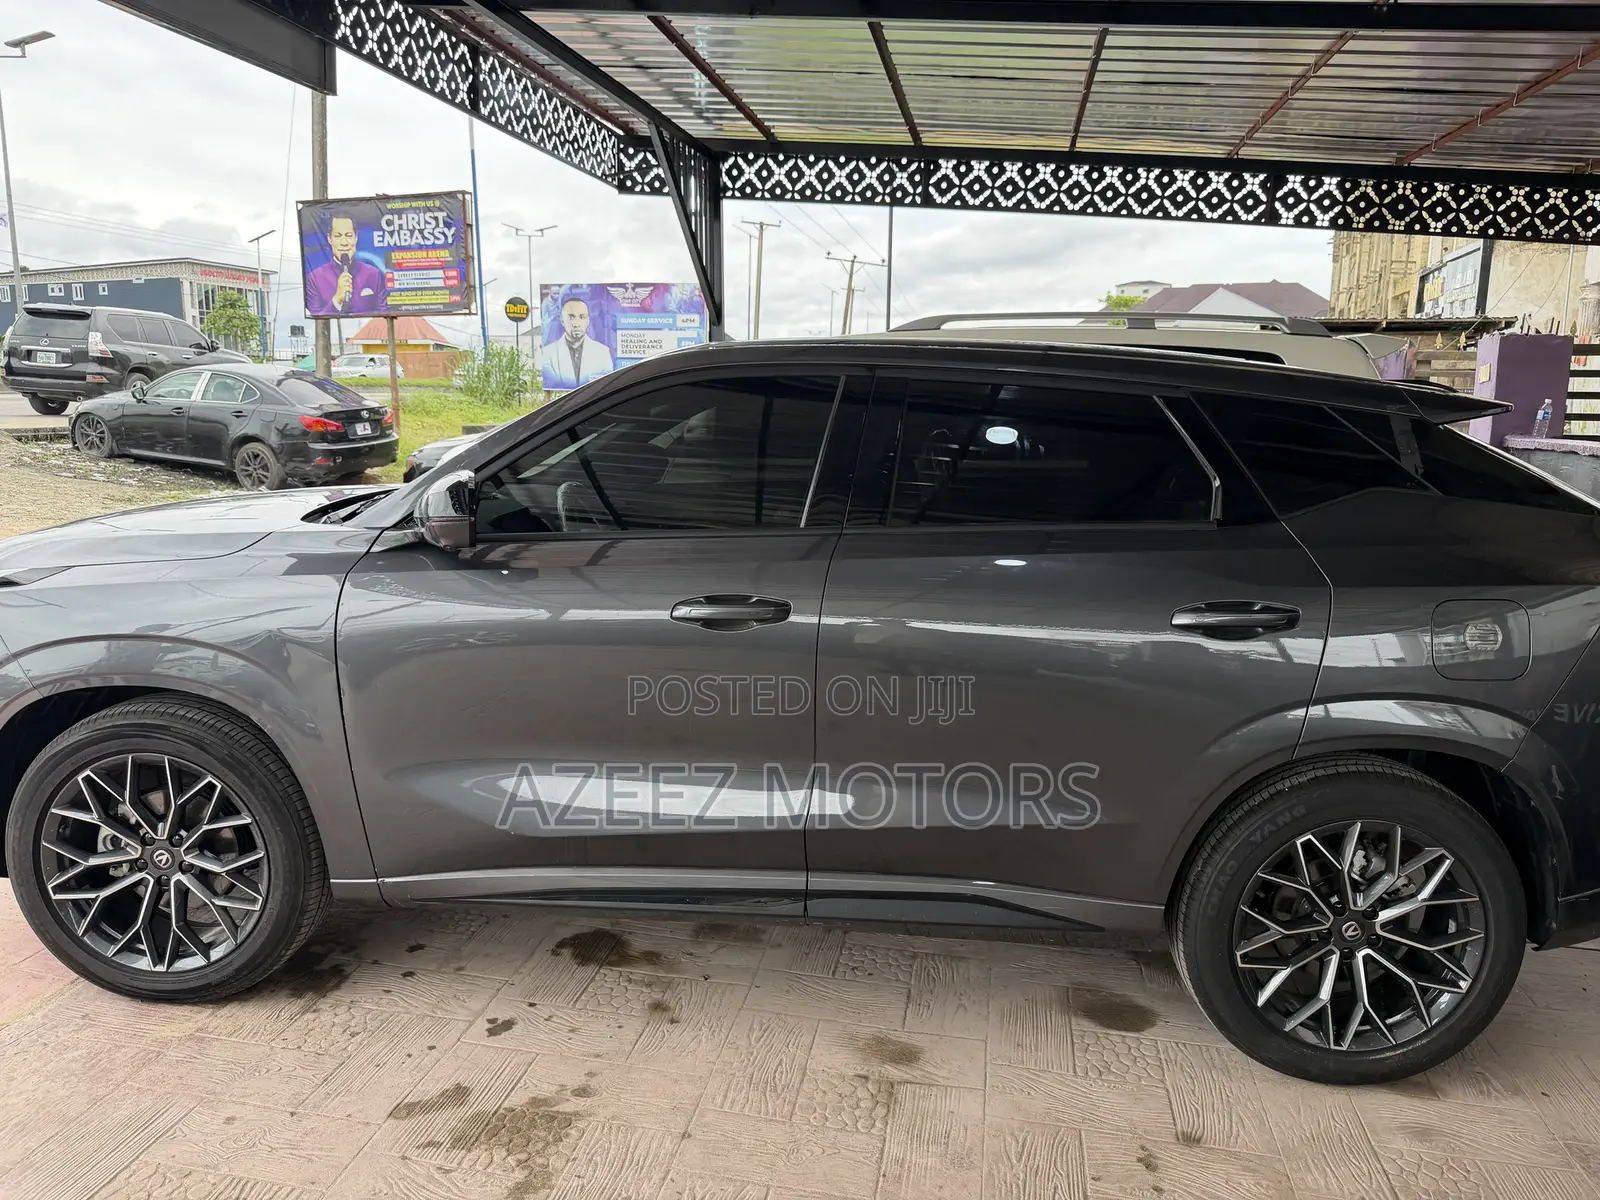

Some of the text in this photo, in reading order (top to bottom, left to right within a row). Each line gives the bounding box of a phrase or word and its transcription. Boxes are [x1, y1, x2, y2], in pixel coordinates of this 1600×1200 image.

[381, 211, 447, 231] CHRIST
[373, 226, 457, 247] EMBASSY
[1249, 805, 1308, 844] YANG
